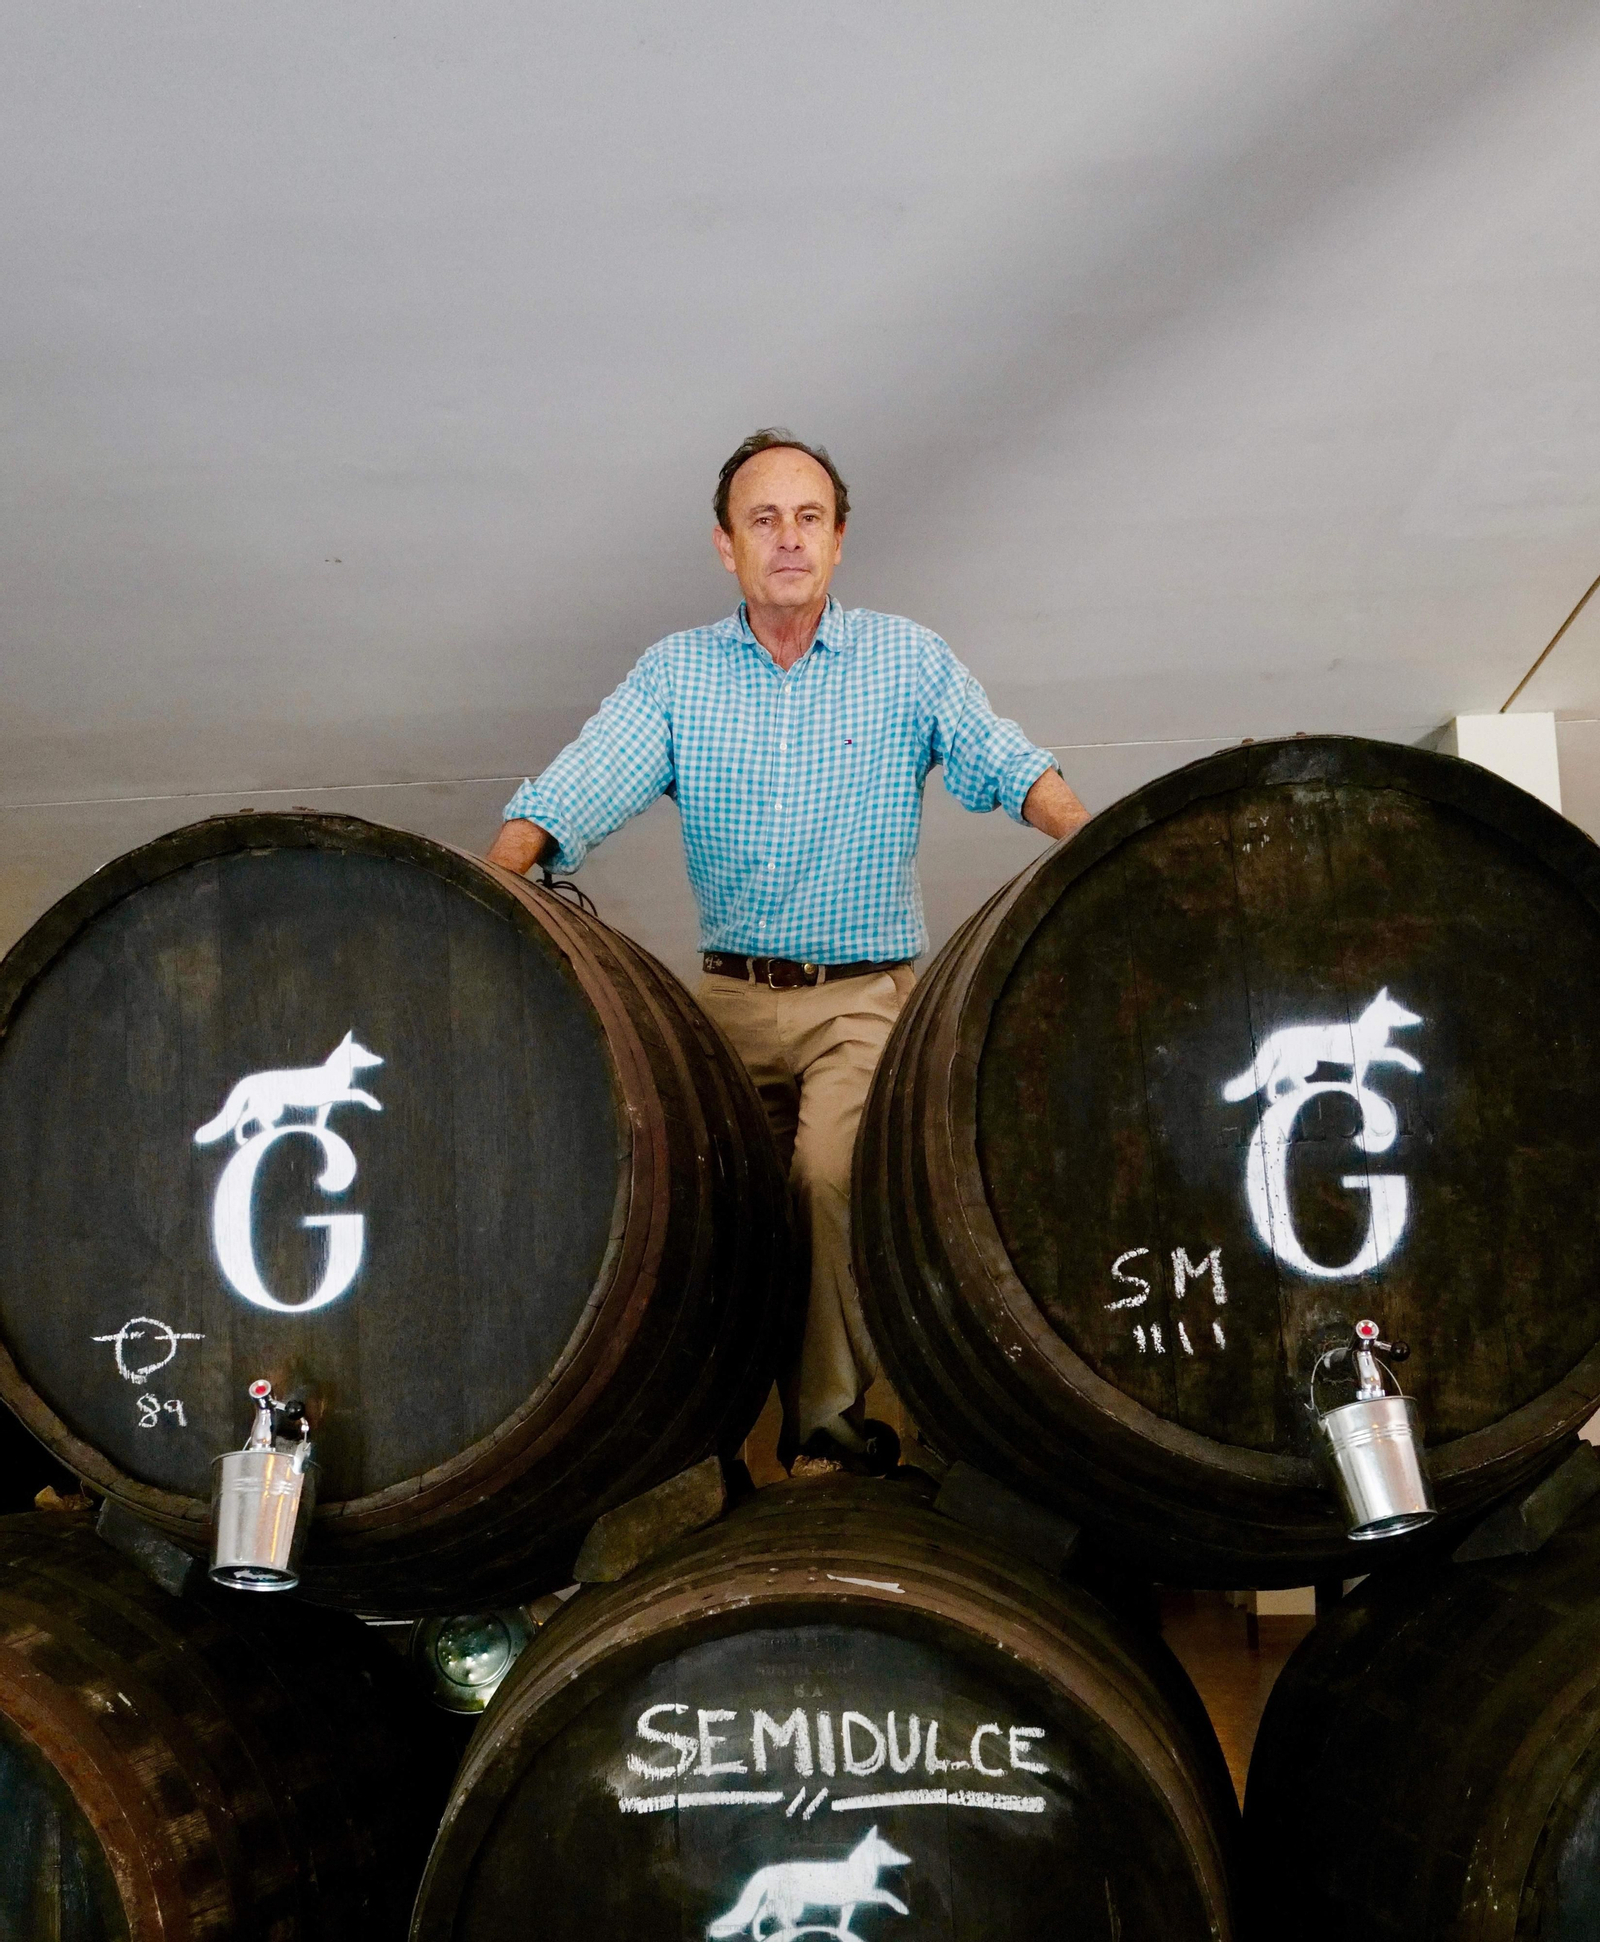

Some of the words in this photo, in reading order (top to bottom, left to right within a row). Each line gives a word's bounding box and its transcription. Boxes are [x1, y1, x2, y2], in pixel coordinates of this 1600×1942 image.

[213, 1125, 364, 1313] G
[1246, 1082, 1409, 1278] G
[627, 1703, 1049, 1778] SEMIDULCE
